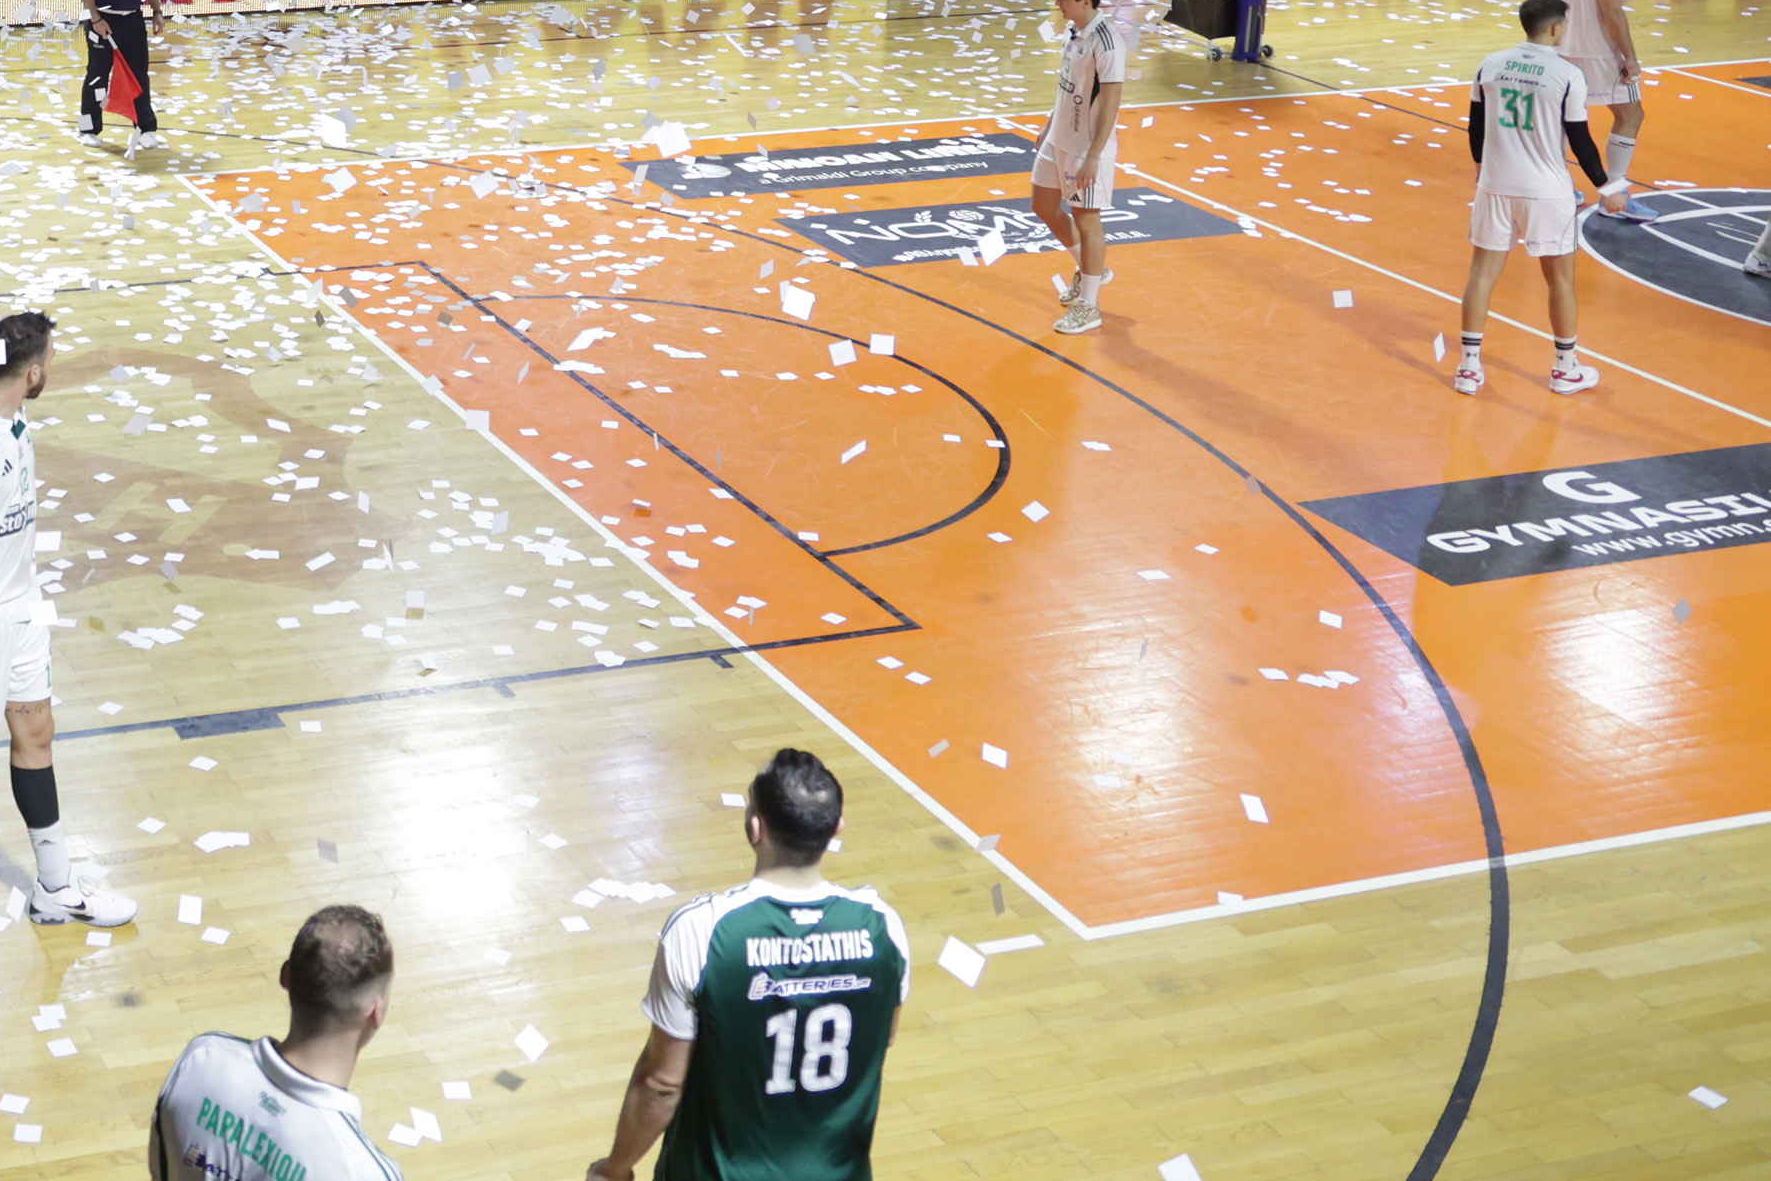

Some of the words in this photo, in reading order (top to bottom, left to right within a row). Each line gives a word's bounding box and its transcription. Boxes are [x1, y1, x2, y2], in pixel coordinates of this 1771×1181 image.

[1504, 60, 1545, 77] SPIRITO
[1499, 87, 1534, 131] 31
[850, 165, 908, 179] Group
[1542, 471, 1642, 504] G
[746, 928, 874, 967] KONTOSTATHIS
[765, 1002, 853, 1095] 18
[196, 1096, 308, 1181] PARALEXIOU
